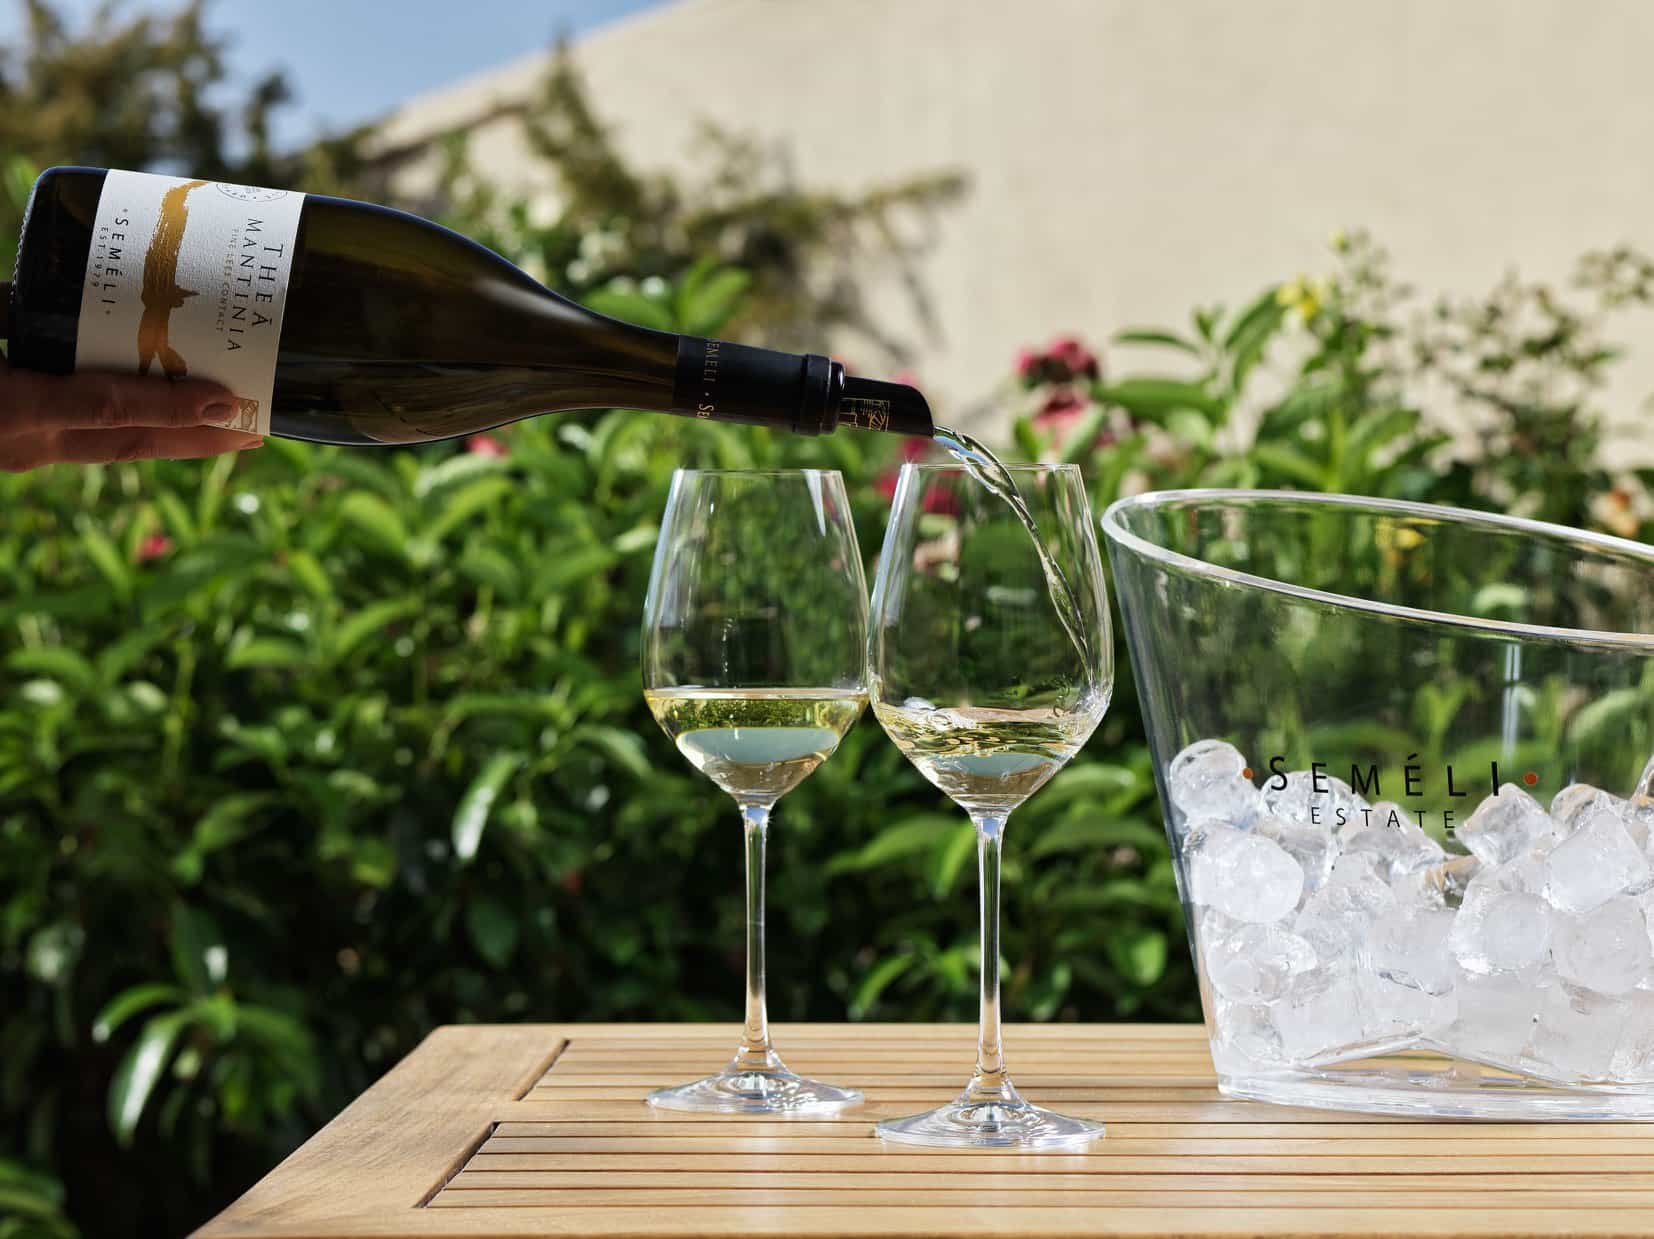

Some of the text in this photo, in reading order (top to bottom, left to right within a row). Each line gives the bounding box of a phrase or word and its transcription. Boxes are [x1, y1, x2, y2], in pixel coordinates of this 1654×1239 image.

[101, 216, 129, 304] SEMÉLI
[226, 217, 264, 351] MANTINIA
[215, 281, 231, 334] CONTACT
[1269, 752, 1500, 797] SEMÉLI
[1311, 806, 1457, 829] ESTATE
